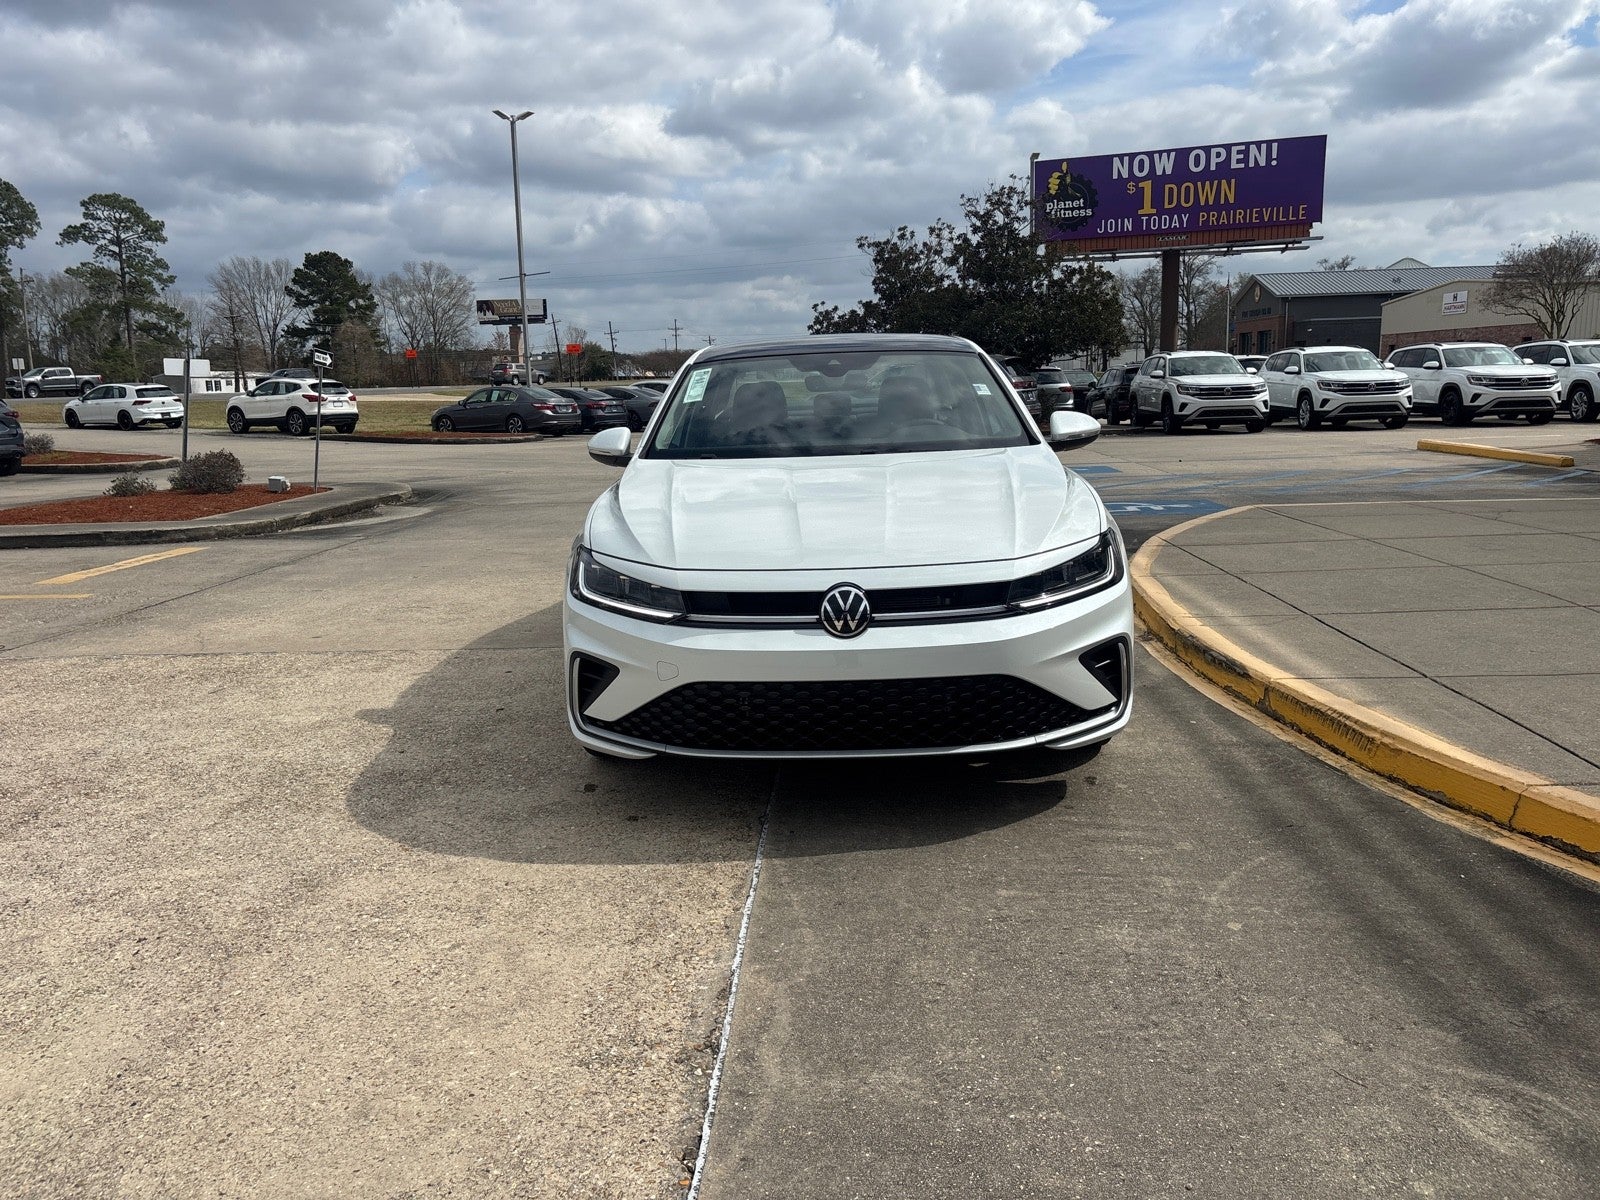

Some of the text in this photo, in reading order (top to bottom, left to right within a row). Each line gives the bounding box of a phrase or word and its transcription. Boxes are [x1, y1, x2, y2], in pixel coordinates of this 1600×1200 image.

[1112, 142, 1278, 180] NOW OPEN!
[1045, 198, 1084, 213] planet
[1126, 179, 1236, 215] $1 DOWN
[1050, 208, 1093, 219] fitness
[1097, 204, 1307, 233] JOIN TODAY PRAIRIEVILLE
